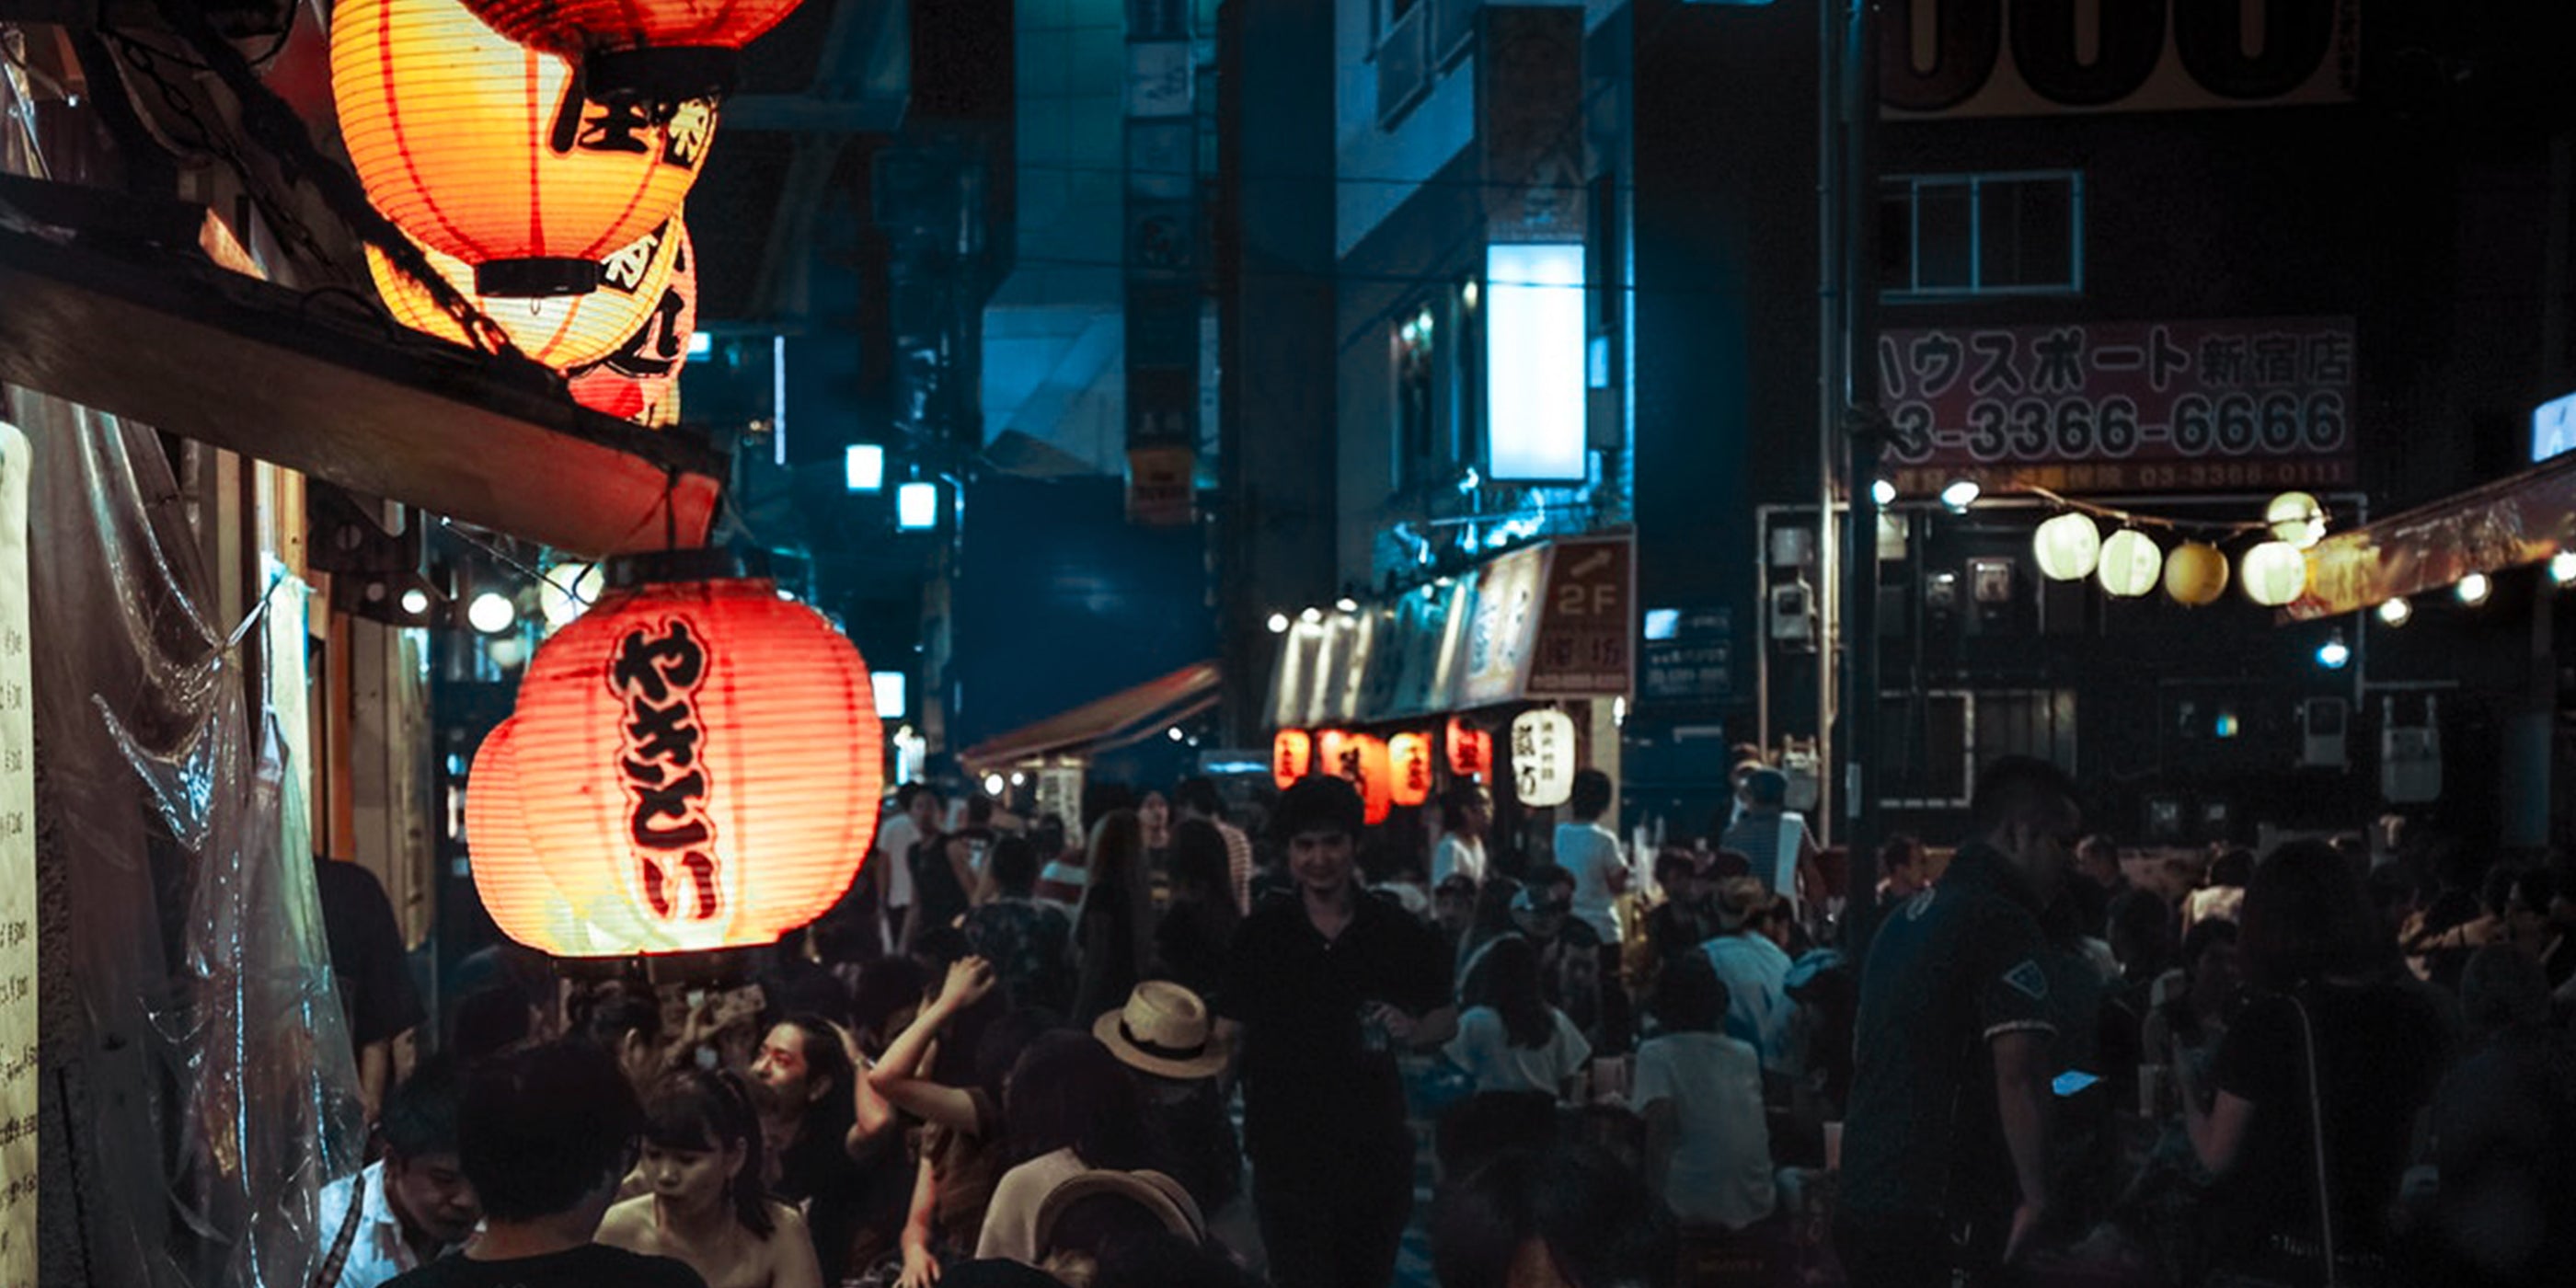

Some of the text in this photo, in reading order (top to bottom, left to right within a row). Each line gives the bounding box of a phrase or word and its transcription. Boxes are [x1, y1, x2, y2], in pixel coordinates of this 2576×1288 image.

[1881, 390, 2345, 464] 3-3366-6666
[1558, 584, 1617, 615] 2F
[610, 616, 721, 922] やきとり
